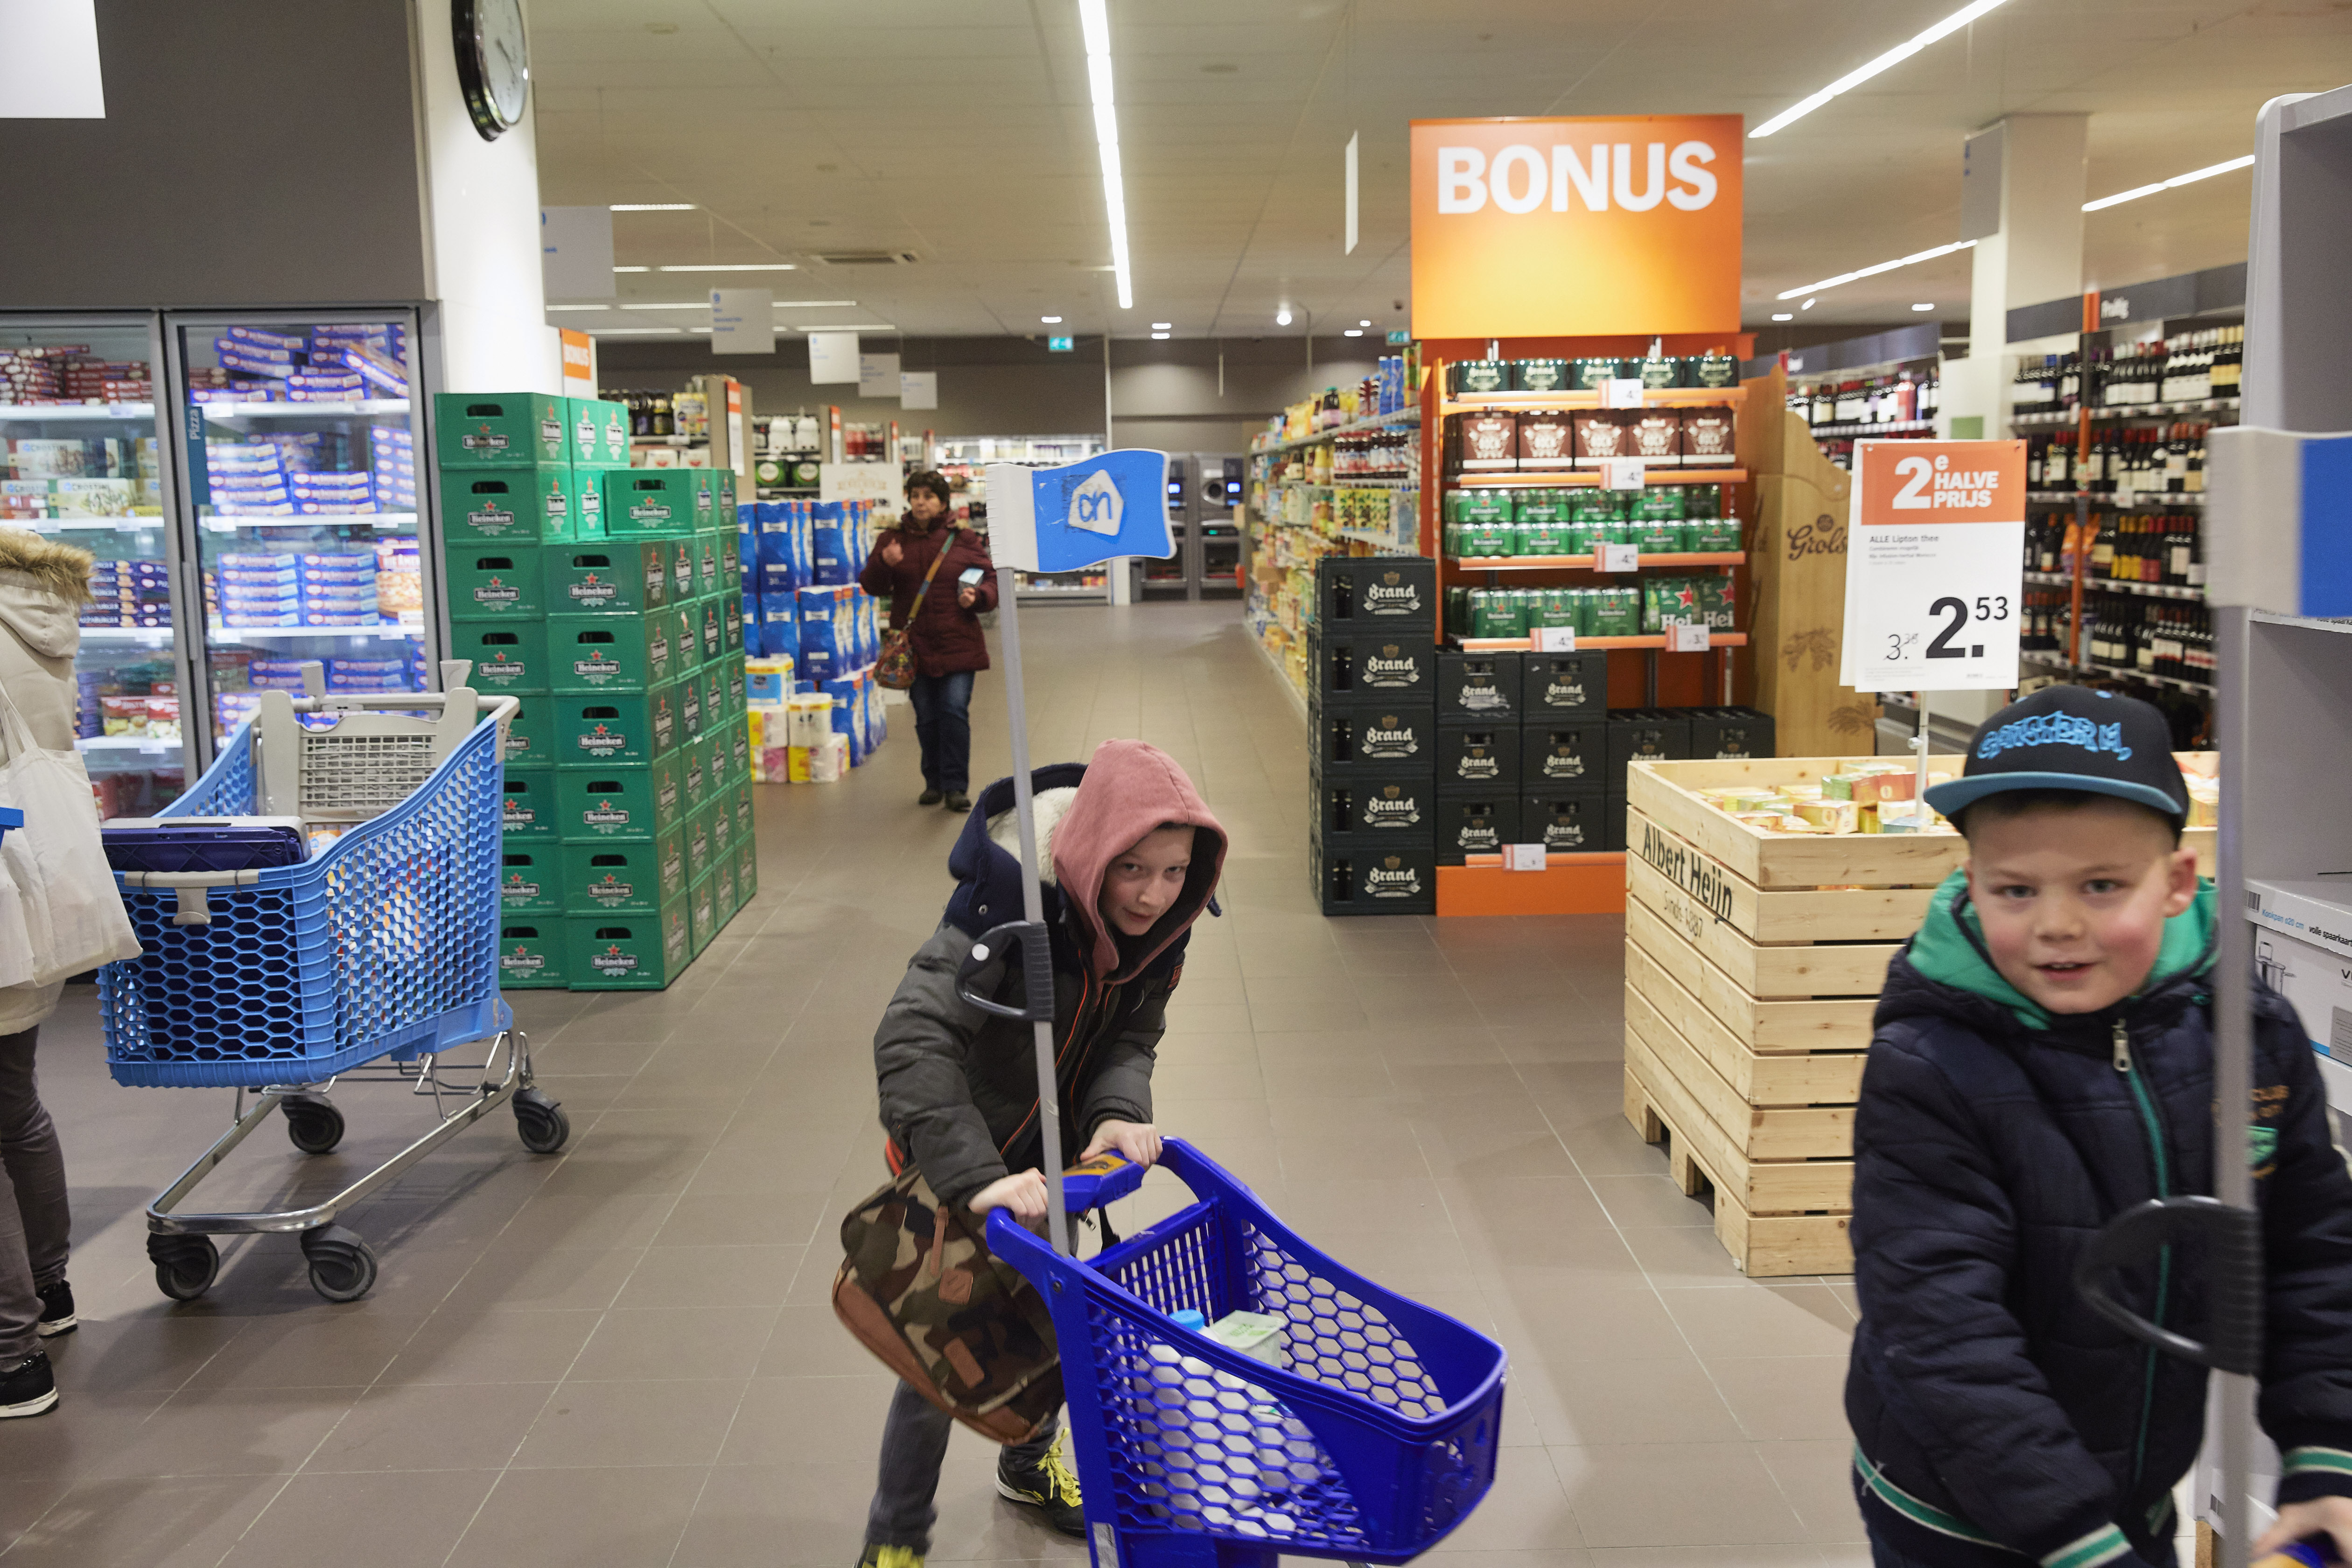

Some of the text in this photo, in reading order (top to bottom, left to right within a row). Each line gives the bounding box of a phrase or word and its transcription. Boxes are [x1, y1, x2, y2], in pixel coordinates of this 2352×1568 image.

[1438, 140, 1717, 214] BONUS
[1934, 471, 1999, 490] HALVE
[1933, 489, 1992, 508] PRIJS
[572, 586, 614, 596] Heineken
[1369, 583, 1415, 600] Brand
[578, 663, 617, 672] Heineken
[1368, 656, 1414, 672] Brand
[1462, 684, 1497, 697] Brand
[1548, 683, 1582, 695] Brand
[581, 736, 623, 747] Heineken
[1366, 727, 1413, 743] Brand
[1461, 756, 1495, 768] Brand
[1547, 754, 1581, 767] Brand
[1368, 796, 1414, 813] Brand
[587, 812, 627, 822] Heineken
[1461, 826, 1495, 839] Brand
[1547, 823, 1581, 835] Brand
[1370, 867, 1416, 884] Brand
[1643, 821, 1732, 920] Albert Heijn
